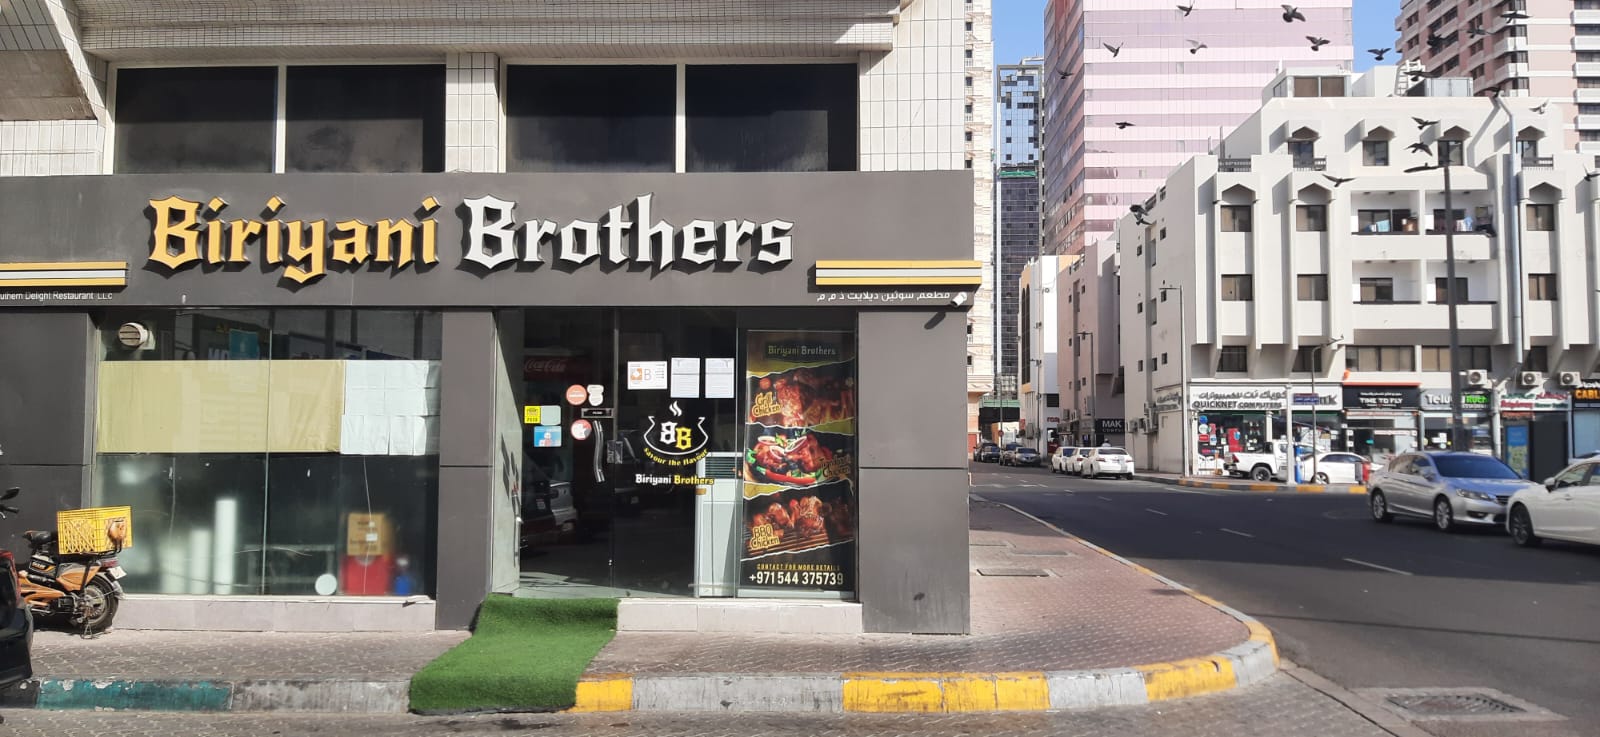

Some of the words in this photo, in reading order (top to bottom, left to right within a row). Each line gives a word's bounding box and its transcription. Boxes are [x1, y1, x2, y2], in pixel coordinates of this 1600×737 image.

[149, 195, 441, 284] Biriyani
[463, 191, 795, 270] Brothers
[53, 291, 94, 300] Restaurant
[916, 291, 950, 302] مطعم
[767, 345, 799, 357] Biriyani
[801, 345, 836, 356] Brothers
[1192, 401, 1237, 410] QUICKNET
[1102, 420, 1122, 428] MAK
[635, 473, 672, 486] Biriyani
[674, 474, 715, 485] Brothers
[753, 525, 773, 538] BBQ
[751, 536, 780, 549] Chicken
[757, 563, 784, 571] CONTACT
[785, 563, 797, 571] FOR
[801, 572, 844, 585] 375739
